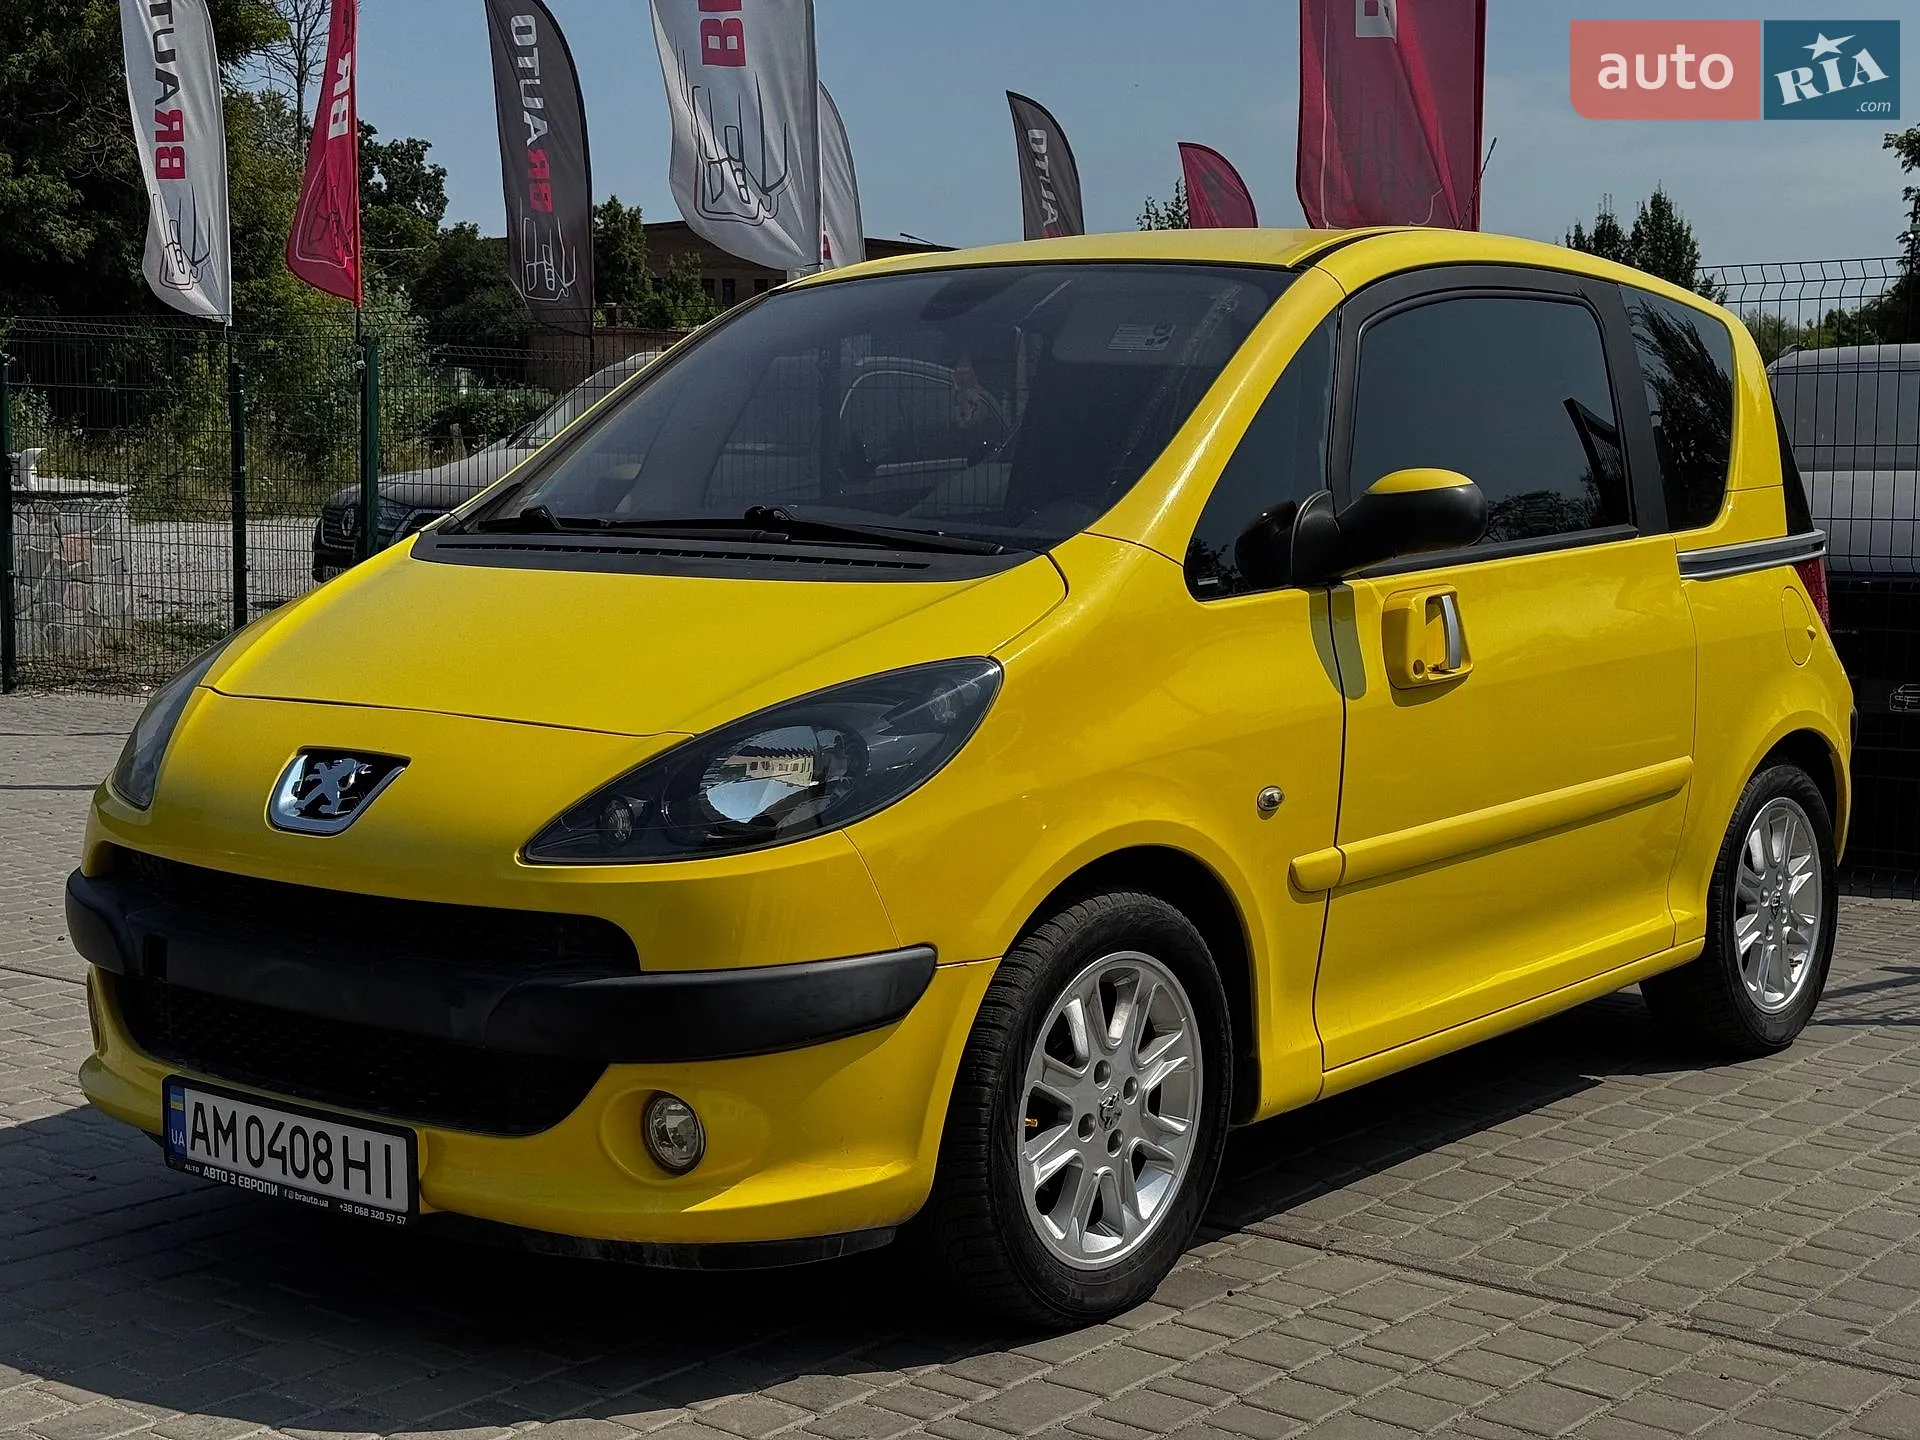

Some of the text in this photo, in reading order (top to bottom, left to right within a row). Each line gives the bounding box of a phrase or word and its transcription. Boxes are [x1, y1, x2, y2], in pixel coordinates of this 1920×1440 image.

[171, 1128, 186, 1147] UA
[203, 1166, 228, 1182] АВТО
[238, 1175, 278, 1197] ЄВРОПИ
[339, 1203, 407, 1225] +38 068 320 57 57
